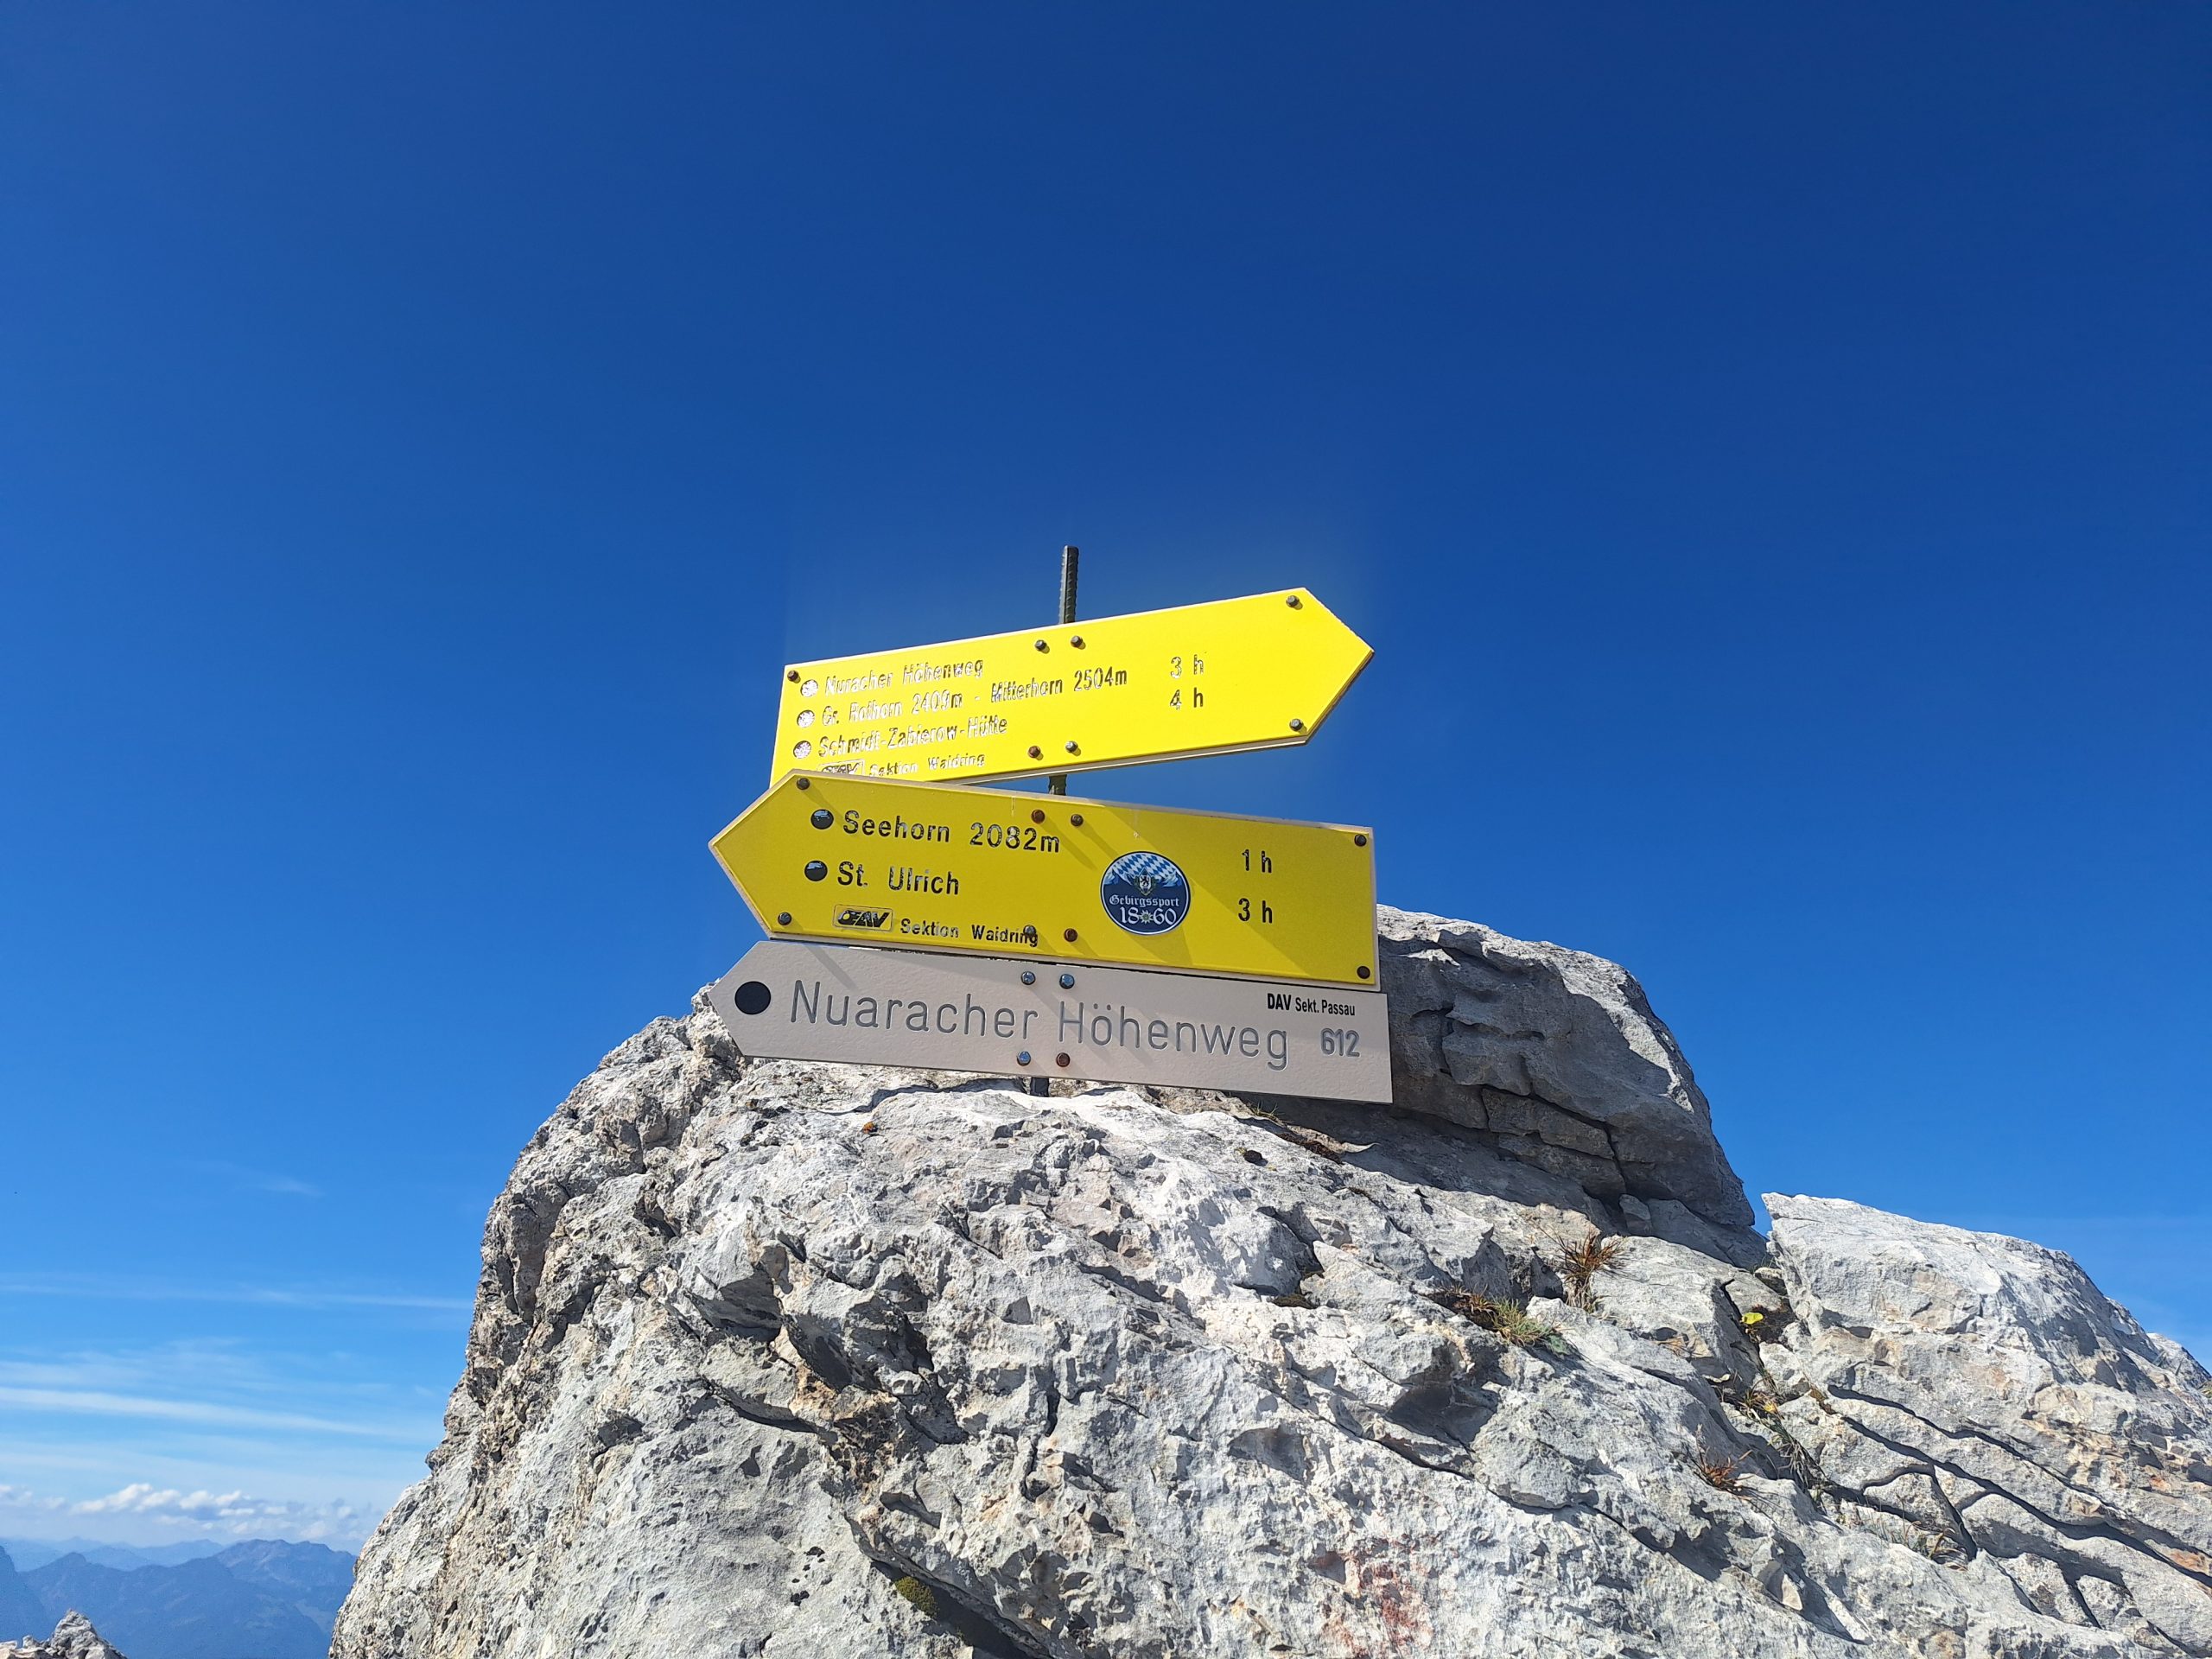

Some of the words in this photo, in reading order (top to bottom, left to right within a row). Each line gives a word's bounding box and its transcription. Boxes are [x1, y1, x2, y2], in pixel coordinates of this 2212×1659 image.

[824, 671, 893, 696] Nuracher
[903, 658, 984, 685] Höhenweg
[1170, 656, 1183, 679] 3
[1193, 654, 1205, 675] h
[822, 705, 840, 727] Gr.
[912, 690, 963, 715] 2409m
[990, 677, 1064, 702] Mitterhorn
[1073, 666, 1128, 692] 2504m
[1169, 689, 1183, 710] 4
[1193, 687, 1205, 708] h
[817, 715, 1008, 758] Schmidt-Zabierow-Hütte
[869, 762, 918, 777] Sektion
[927, 753, 986, 772] Waidring
[842, 810, 950, 842] Seehorn
[969, 822, 1060, 853] 2082m
[1241, 849, 1250, 871] 1
[1261, 850, 1273, 874] h
[836, 861, 868, 887] St.
[888, 866, 960, 895] Ulrich
[1109, 894, 1180, 907] Gebirgssport
[1237, 897, 1251, 922] 3
[1262, 899, 1273, 924] h
[899, 918, 959, 938] Sektion
[971, 925, 1039, 948] Waidring
[1267, 992, 1292, 1011] DAV
[1295, 997, 1319, 1014] Sekt.
[1321, 999, 1356, 1017] Passau
[790, 979, 1039, 1039] Nuaracher
[1058, 1000, 1288, 1071] Höhenweg
[1319, 1027, 1361, 1058] 612
